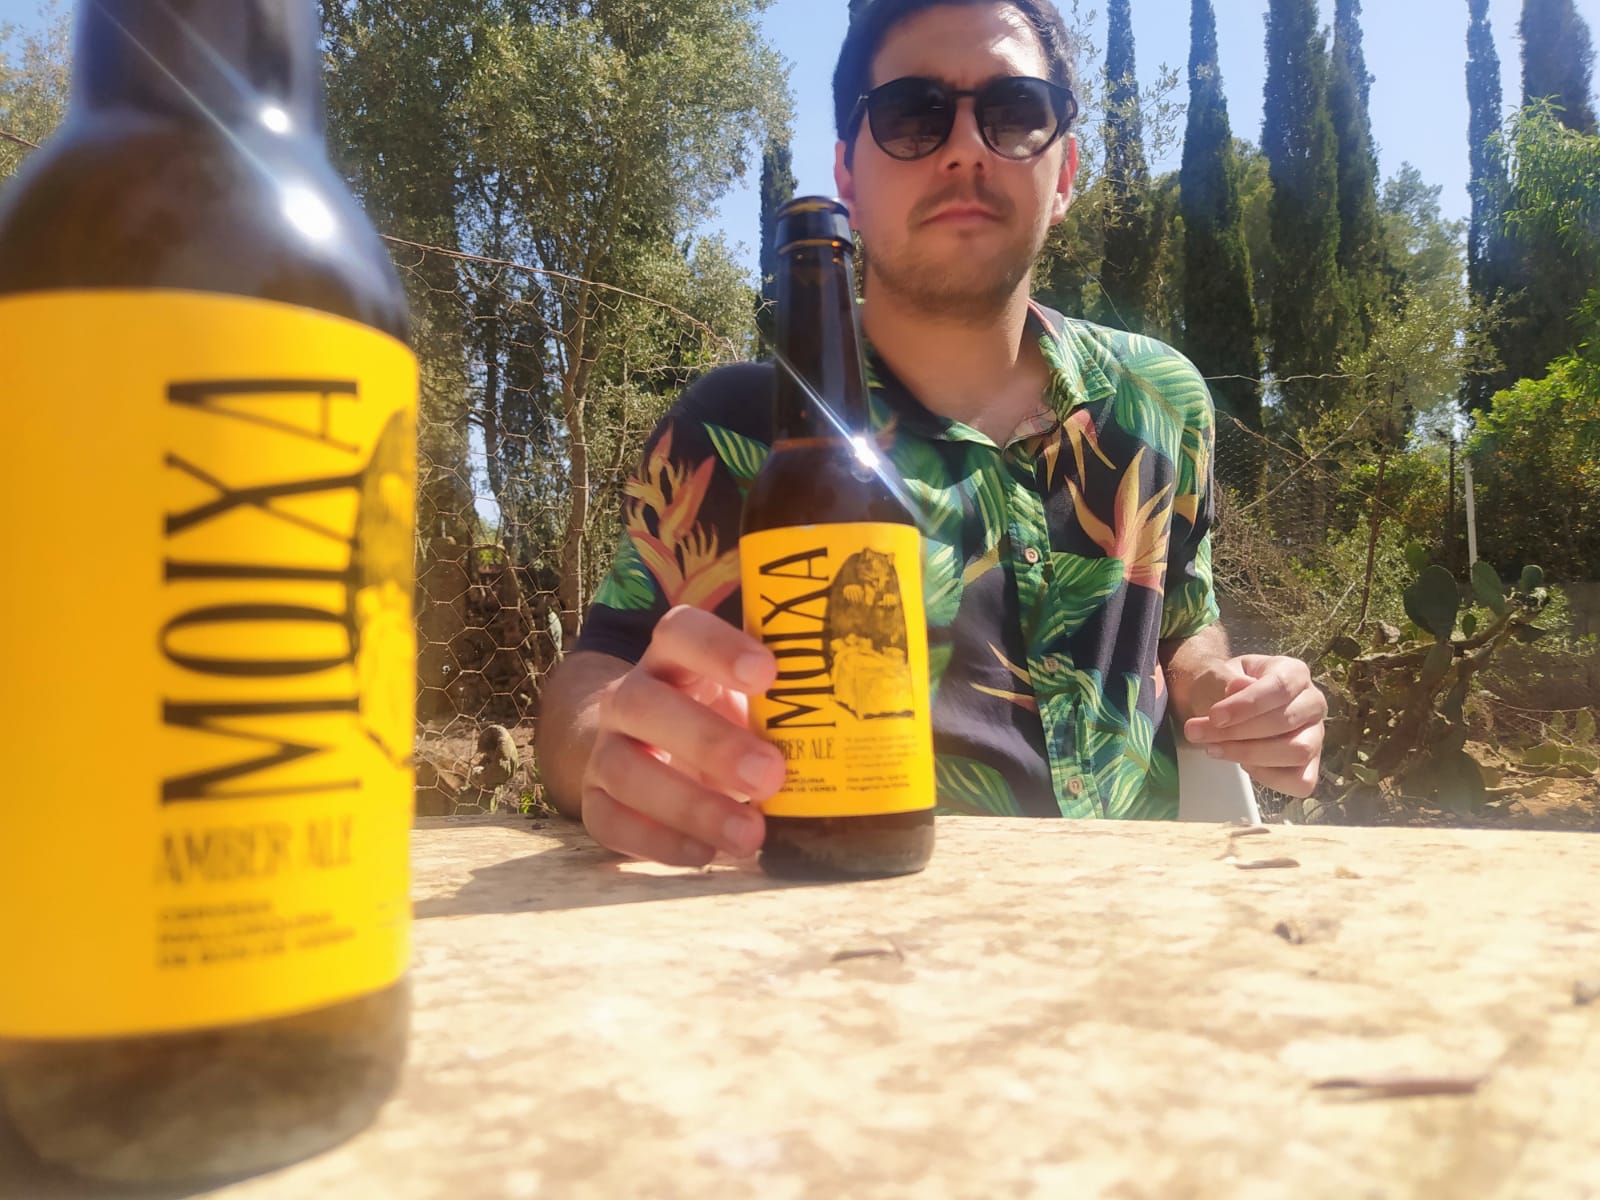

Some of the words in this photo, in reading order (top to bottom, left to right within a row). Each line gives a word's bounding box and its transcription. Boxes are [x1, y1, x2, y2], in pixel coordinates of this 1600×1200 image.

[162, 378, 360, 803] MOIXA
[759, 547, 836, 730] MOIXA
[768, 739, 805, 761] BER
[809, 738, 835, 759] ALE
